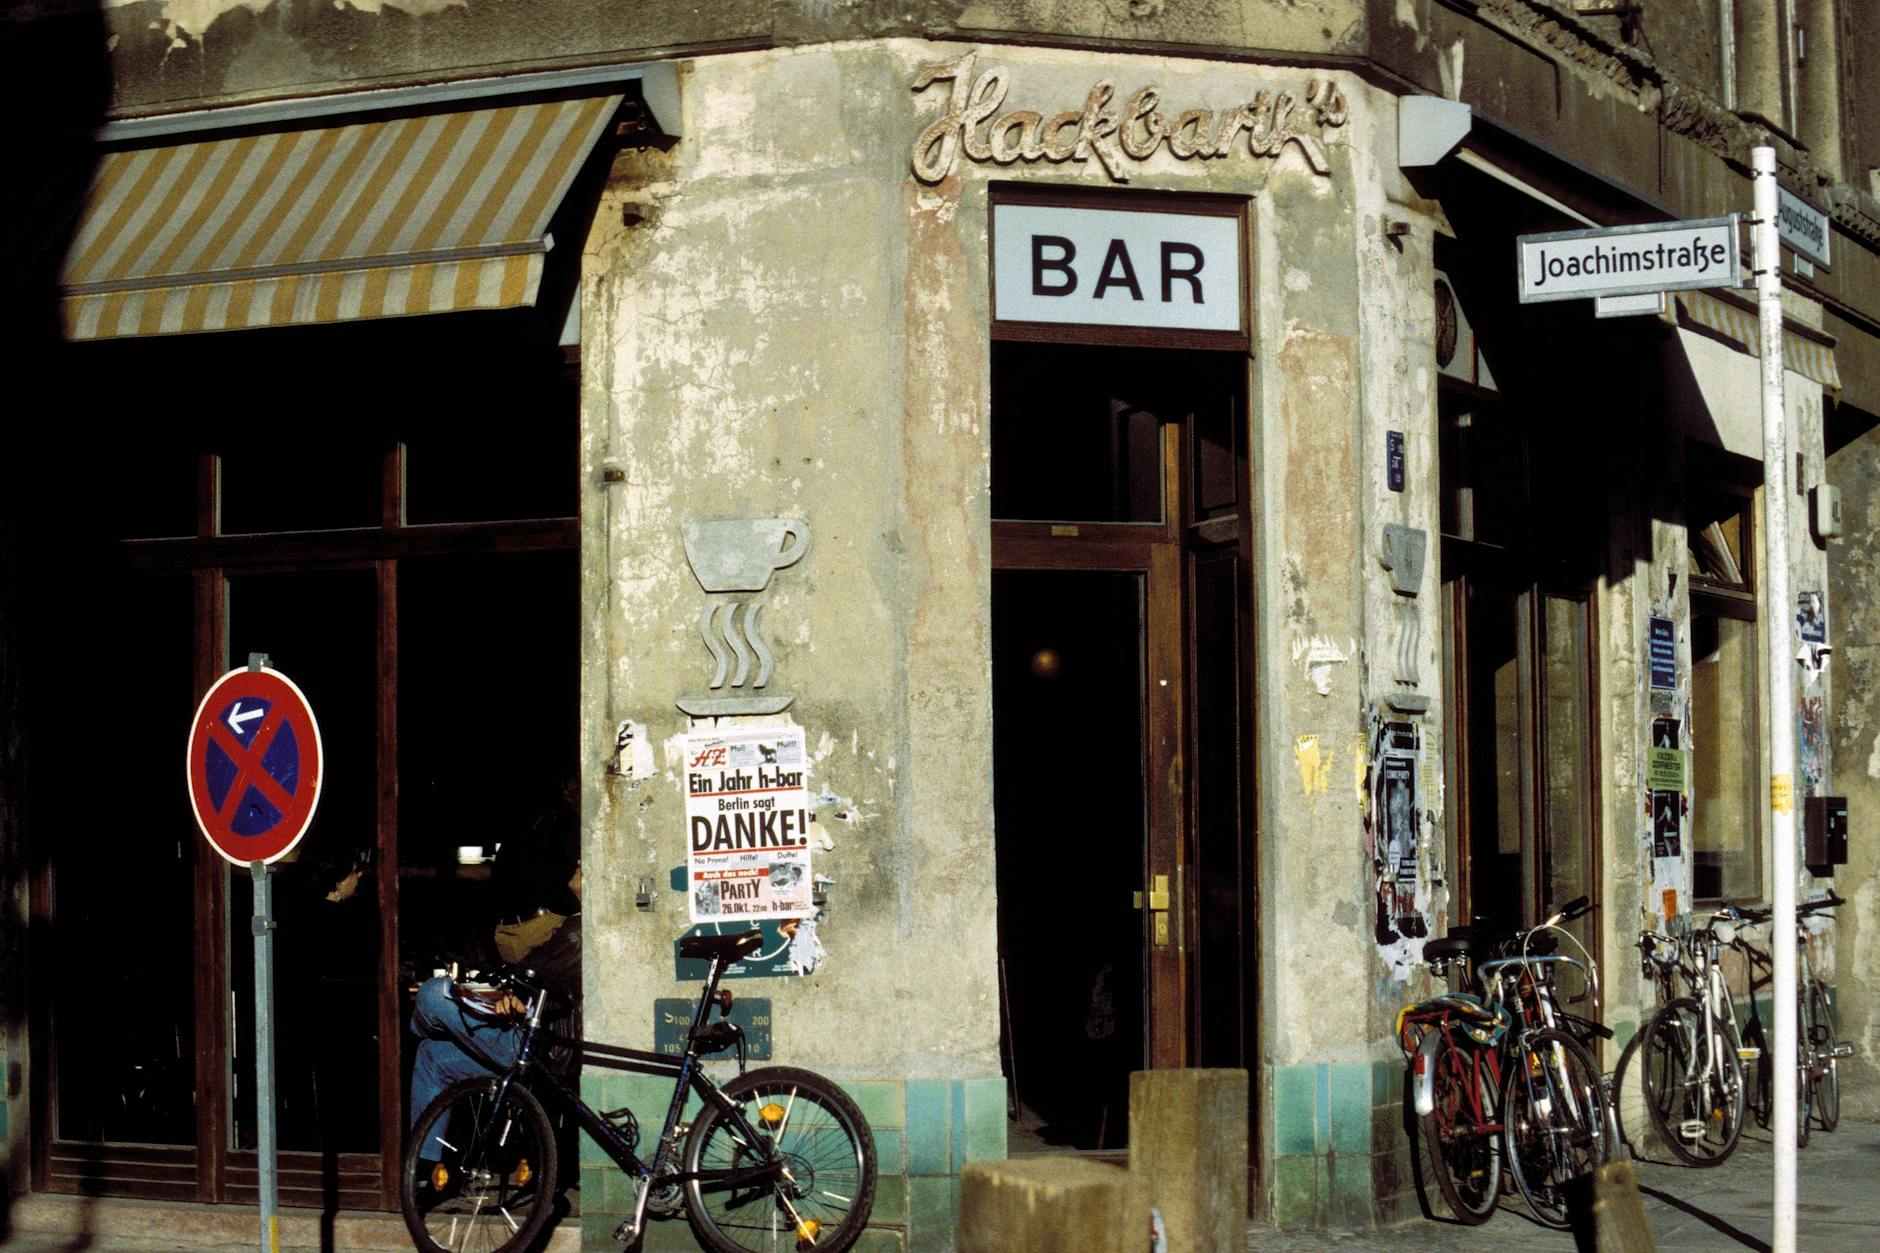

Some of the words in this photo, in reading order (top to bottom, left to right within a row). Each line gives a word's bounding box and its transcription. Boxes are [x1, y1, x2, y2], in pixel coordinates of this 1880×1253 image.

[911, 50, 1349, 186] Hackbarth's
[1031, 233, 1206, 304] BAR
[1534, 236, 1726, 286] Joachimstraße
[689, 773, 713, 793] Ein
[718, 768, 753, 792] Jahr
[758, 766, 803, 789] h-bar
[718, 798, 750, 811] Berlin
[753, 796, 775, 810] sagt
[691, 808, 807, 852] DANKE!
[707, 856, 729, 864] Prima!
[739, 853, 758, 861] Hilfe!
[752, 1016, 770, 1025] 200
